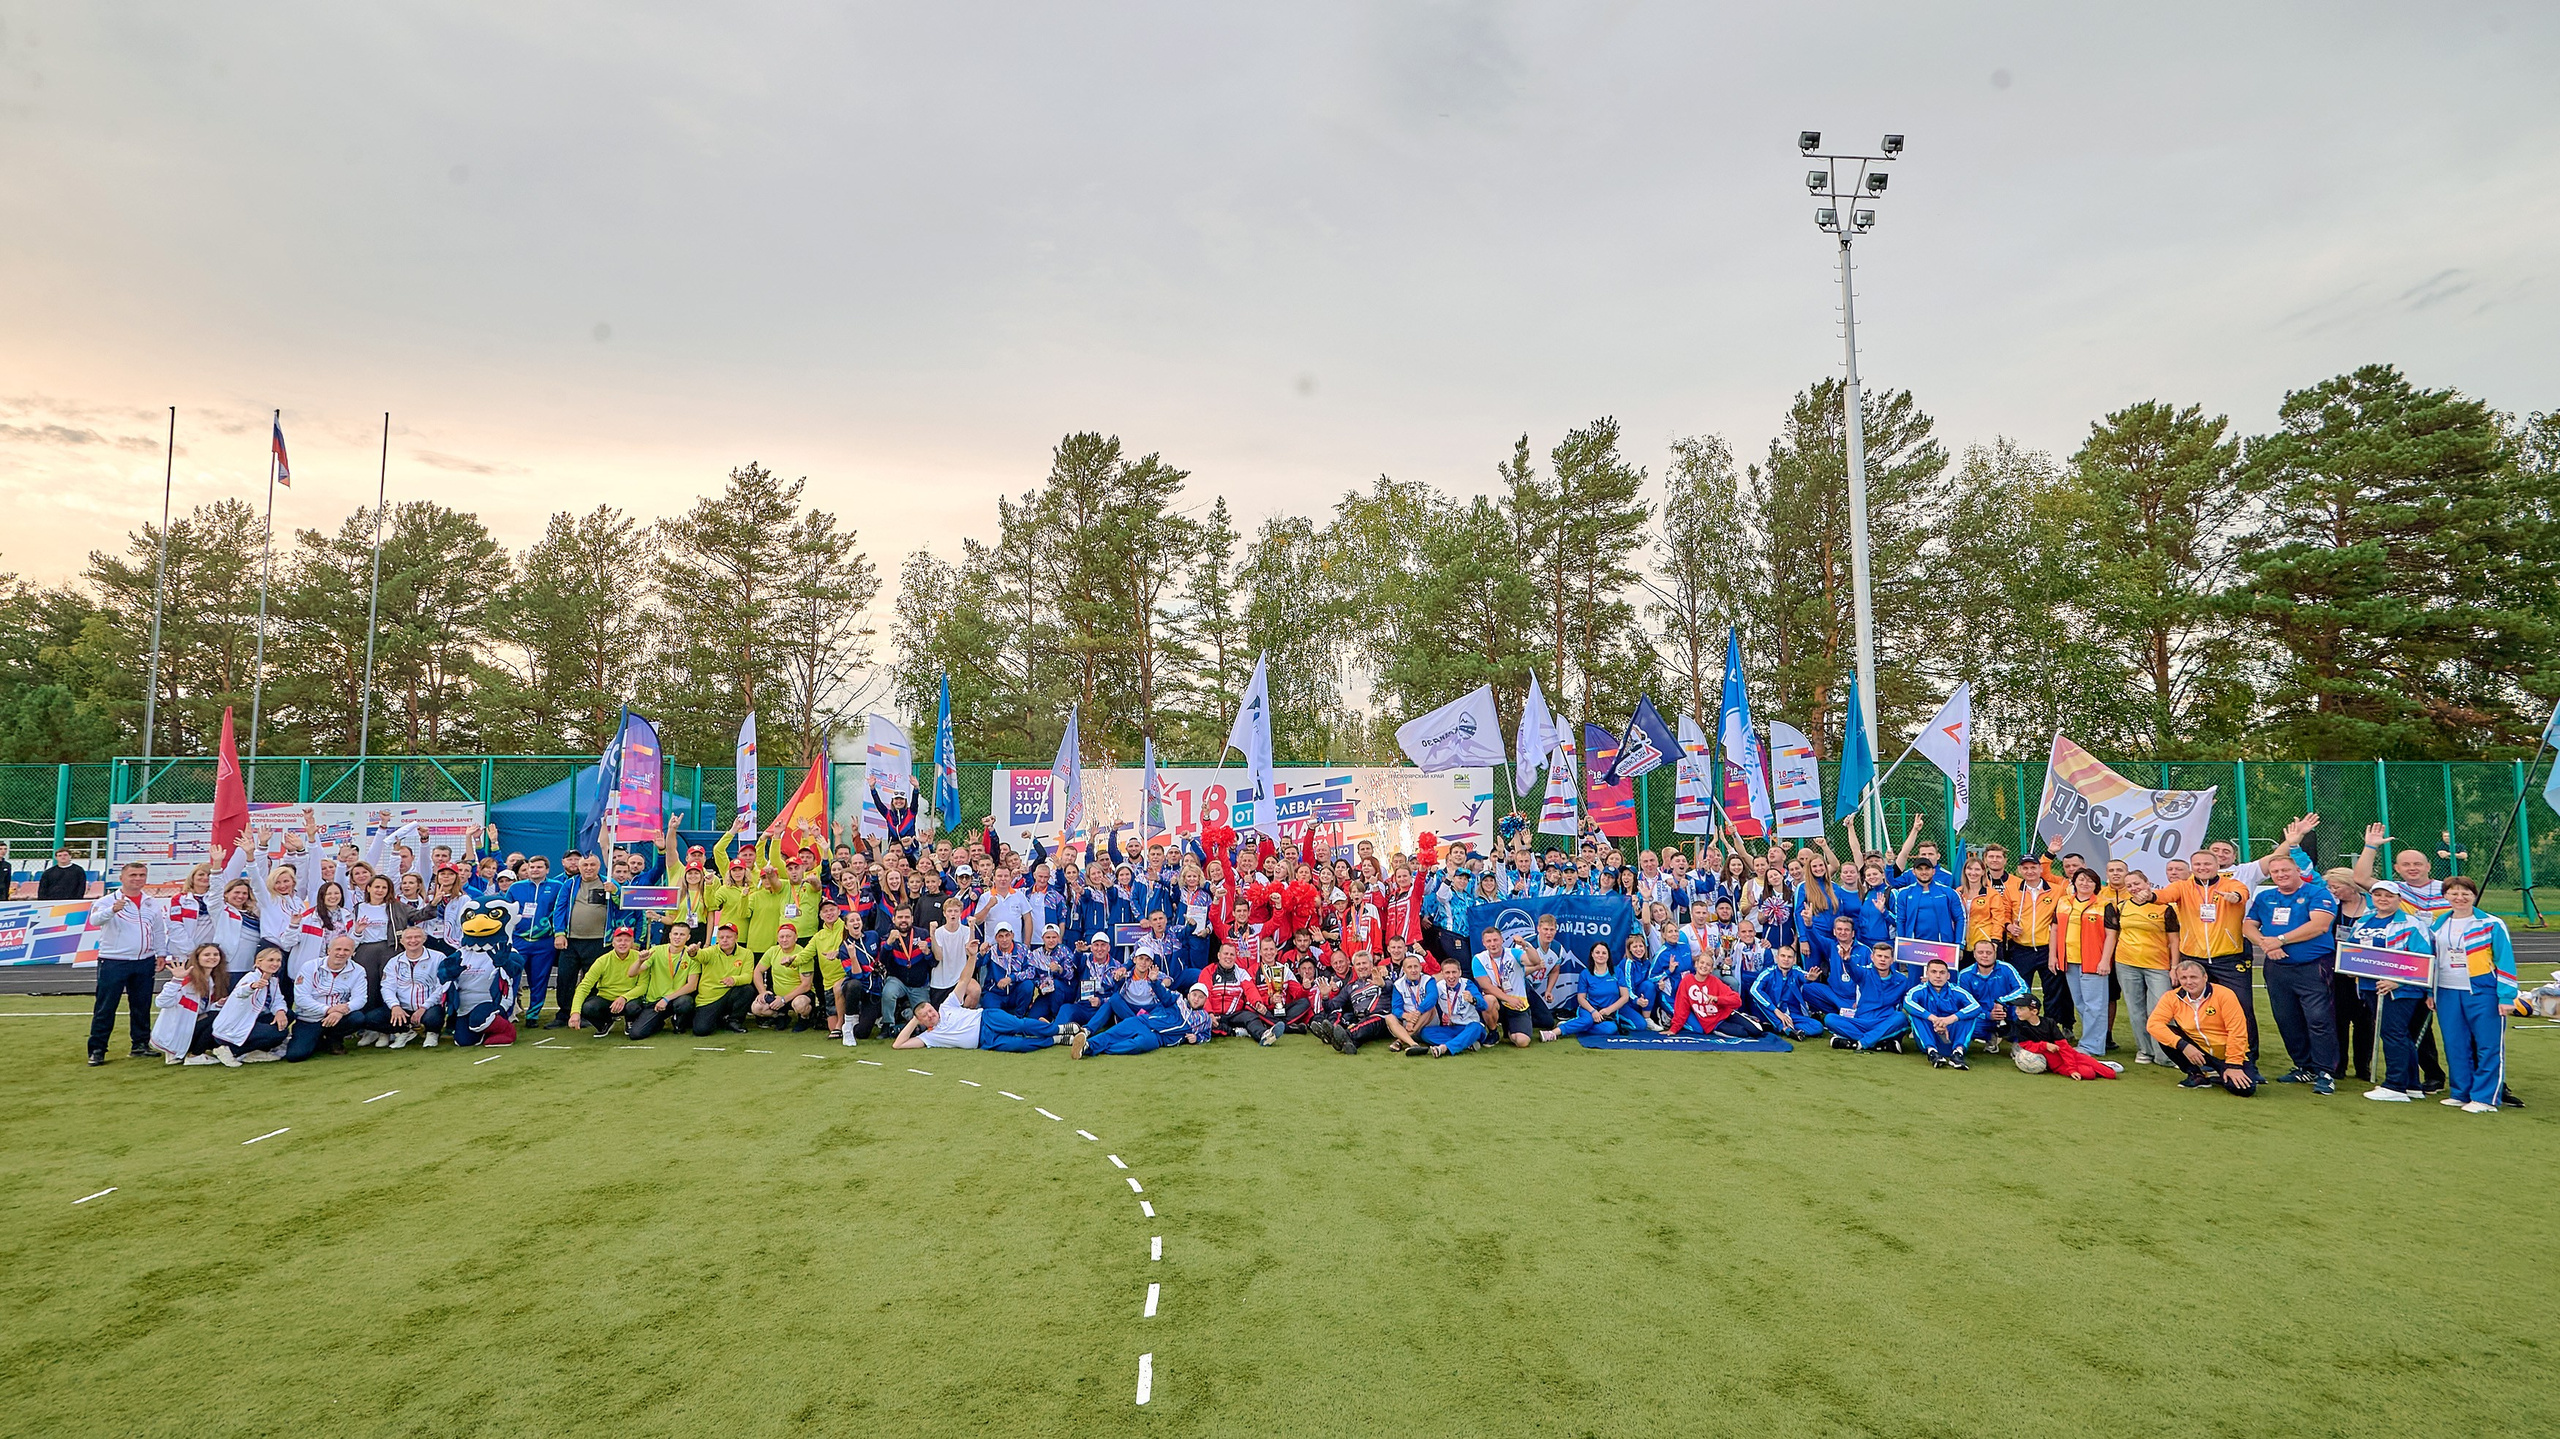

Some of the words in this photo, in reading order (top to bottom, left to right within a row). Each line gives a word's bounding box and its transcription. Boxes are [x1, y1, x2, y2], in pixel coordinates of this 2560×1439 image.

[1593, 770, 1603, 780] 18
[1730, 767, 1739, 776] 18
[1778, 770, 1787, 779] 18
[1015, 776, 1049, 786] 30.08
[1014, 802, 1050, 815] 2024
[1175, 784, 1230, 836] 18
[2050, 783, 2182, 860] ДРСУ-10
[1579, 914, 1612, 922] ОБЩЕСТВО
[2351, 956, 2399, 969] КАРАТУЗСКОЕ
[2399, 964, 2419, 972] ДРСУ
